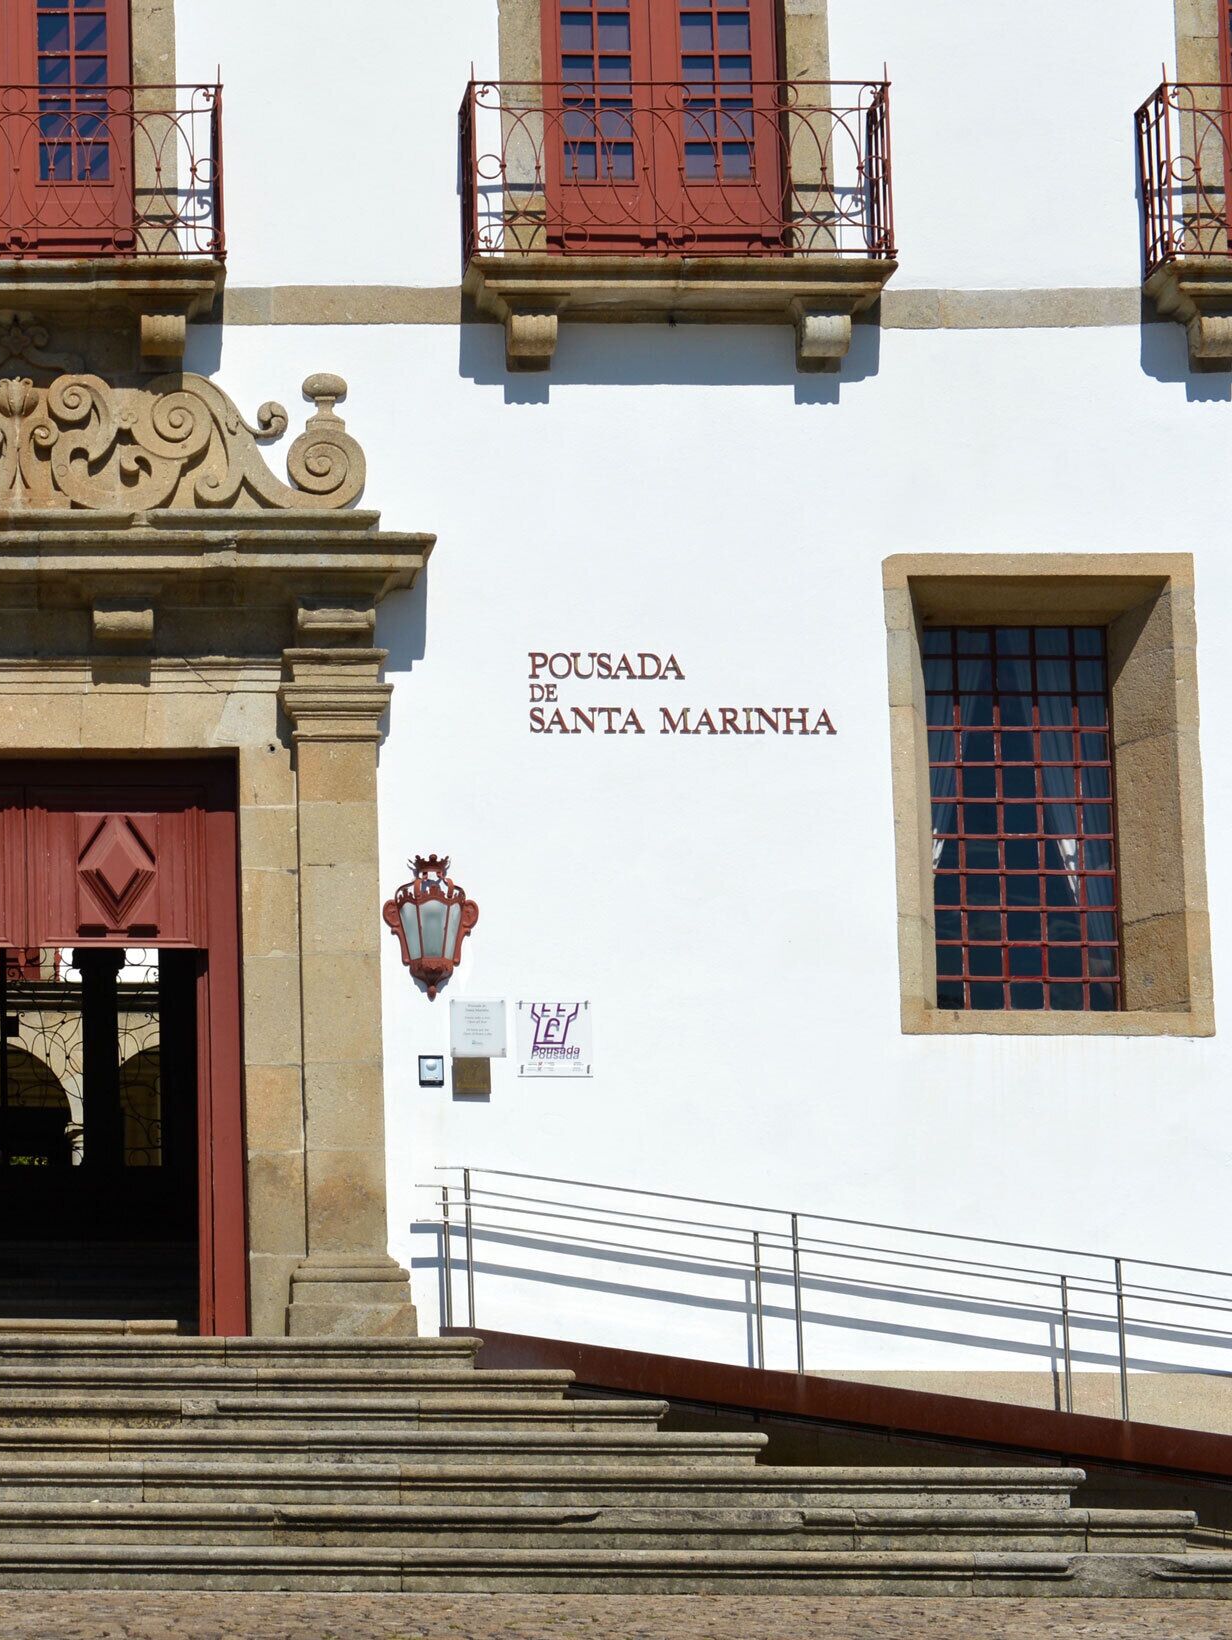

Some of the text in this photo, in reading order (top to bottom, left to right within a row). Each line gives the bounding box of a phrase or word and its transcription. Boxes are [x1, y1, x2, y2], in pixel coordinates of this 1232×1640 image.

[528, 652, 685, 681] POUSADA
[529, 683, 558, 703] DE
[529, 706, 838, 736] SANTA MARINHA
[532, 1045, 580, 1055] Pousada
